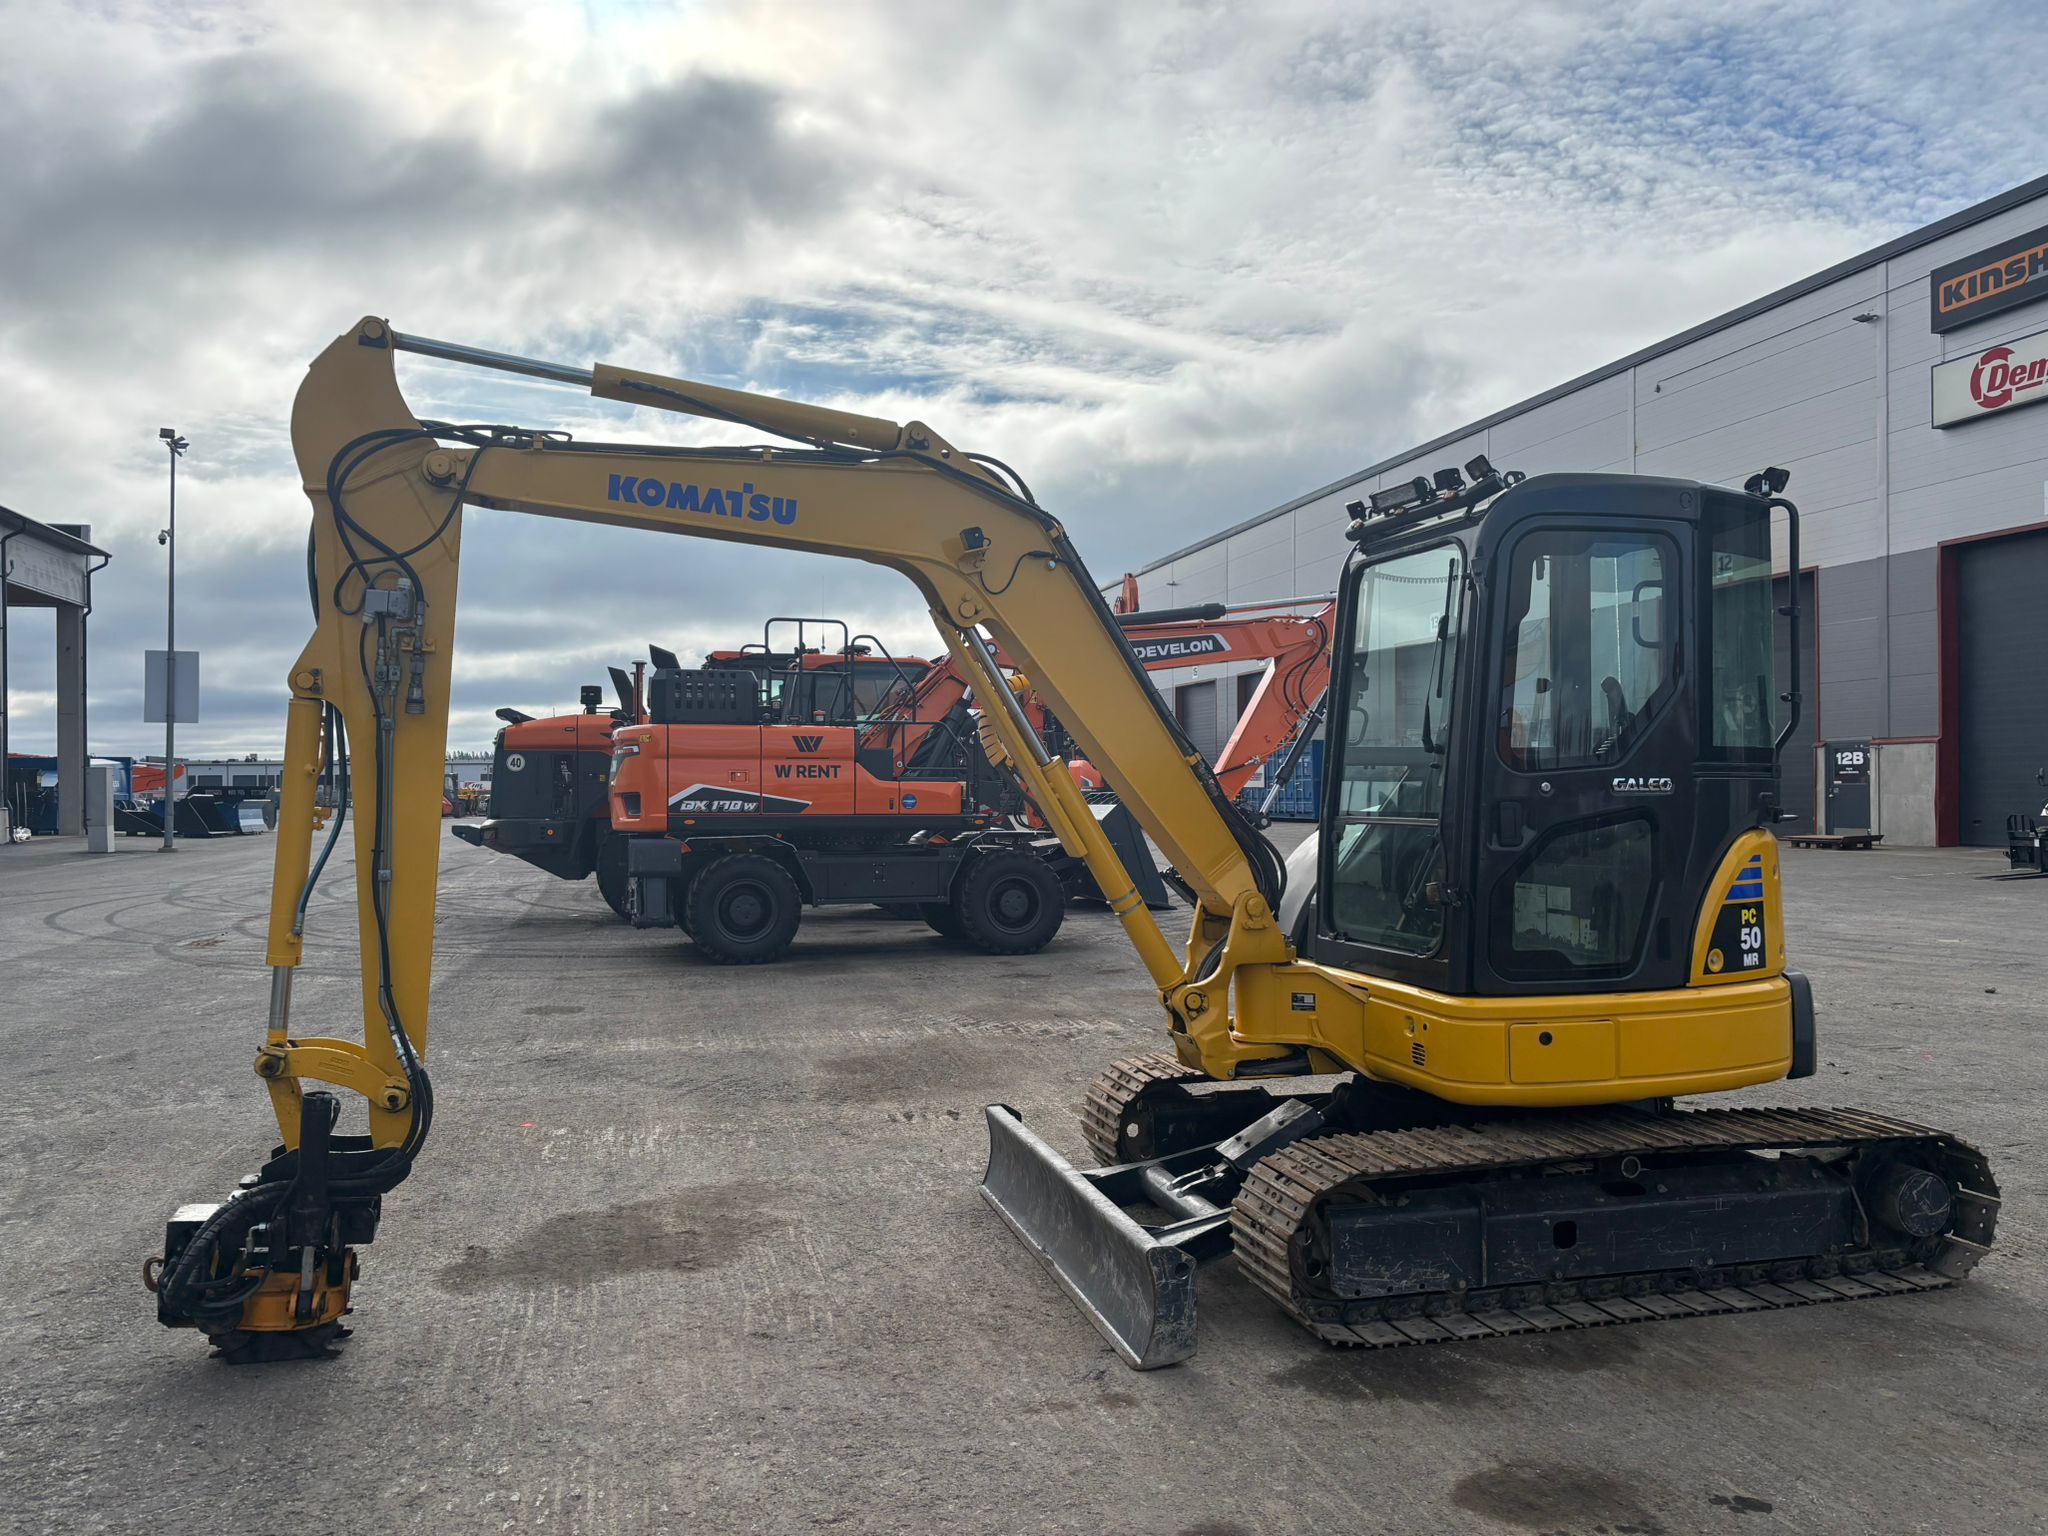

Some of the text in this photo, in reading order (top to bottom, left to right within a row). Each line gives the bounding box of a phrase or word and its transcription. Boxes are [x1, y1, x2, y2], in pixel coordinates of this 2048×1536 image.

[608, 474, 798, 525] KOMATSU
[1717, 555, 1732, 572] 12
[1133, 640, 1214, 658] DEVELON
[510, 758, 521, 768] 40
[1836, 752, 1864, 765] 12B
[775, 765, 841, 778] W RENT
[1741, 909, 1757, 924] PC
[1740, 926, 1762, 950] 50
[1743, 952, 1759, 966] MR
